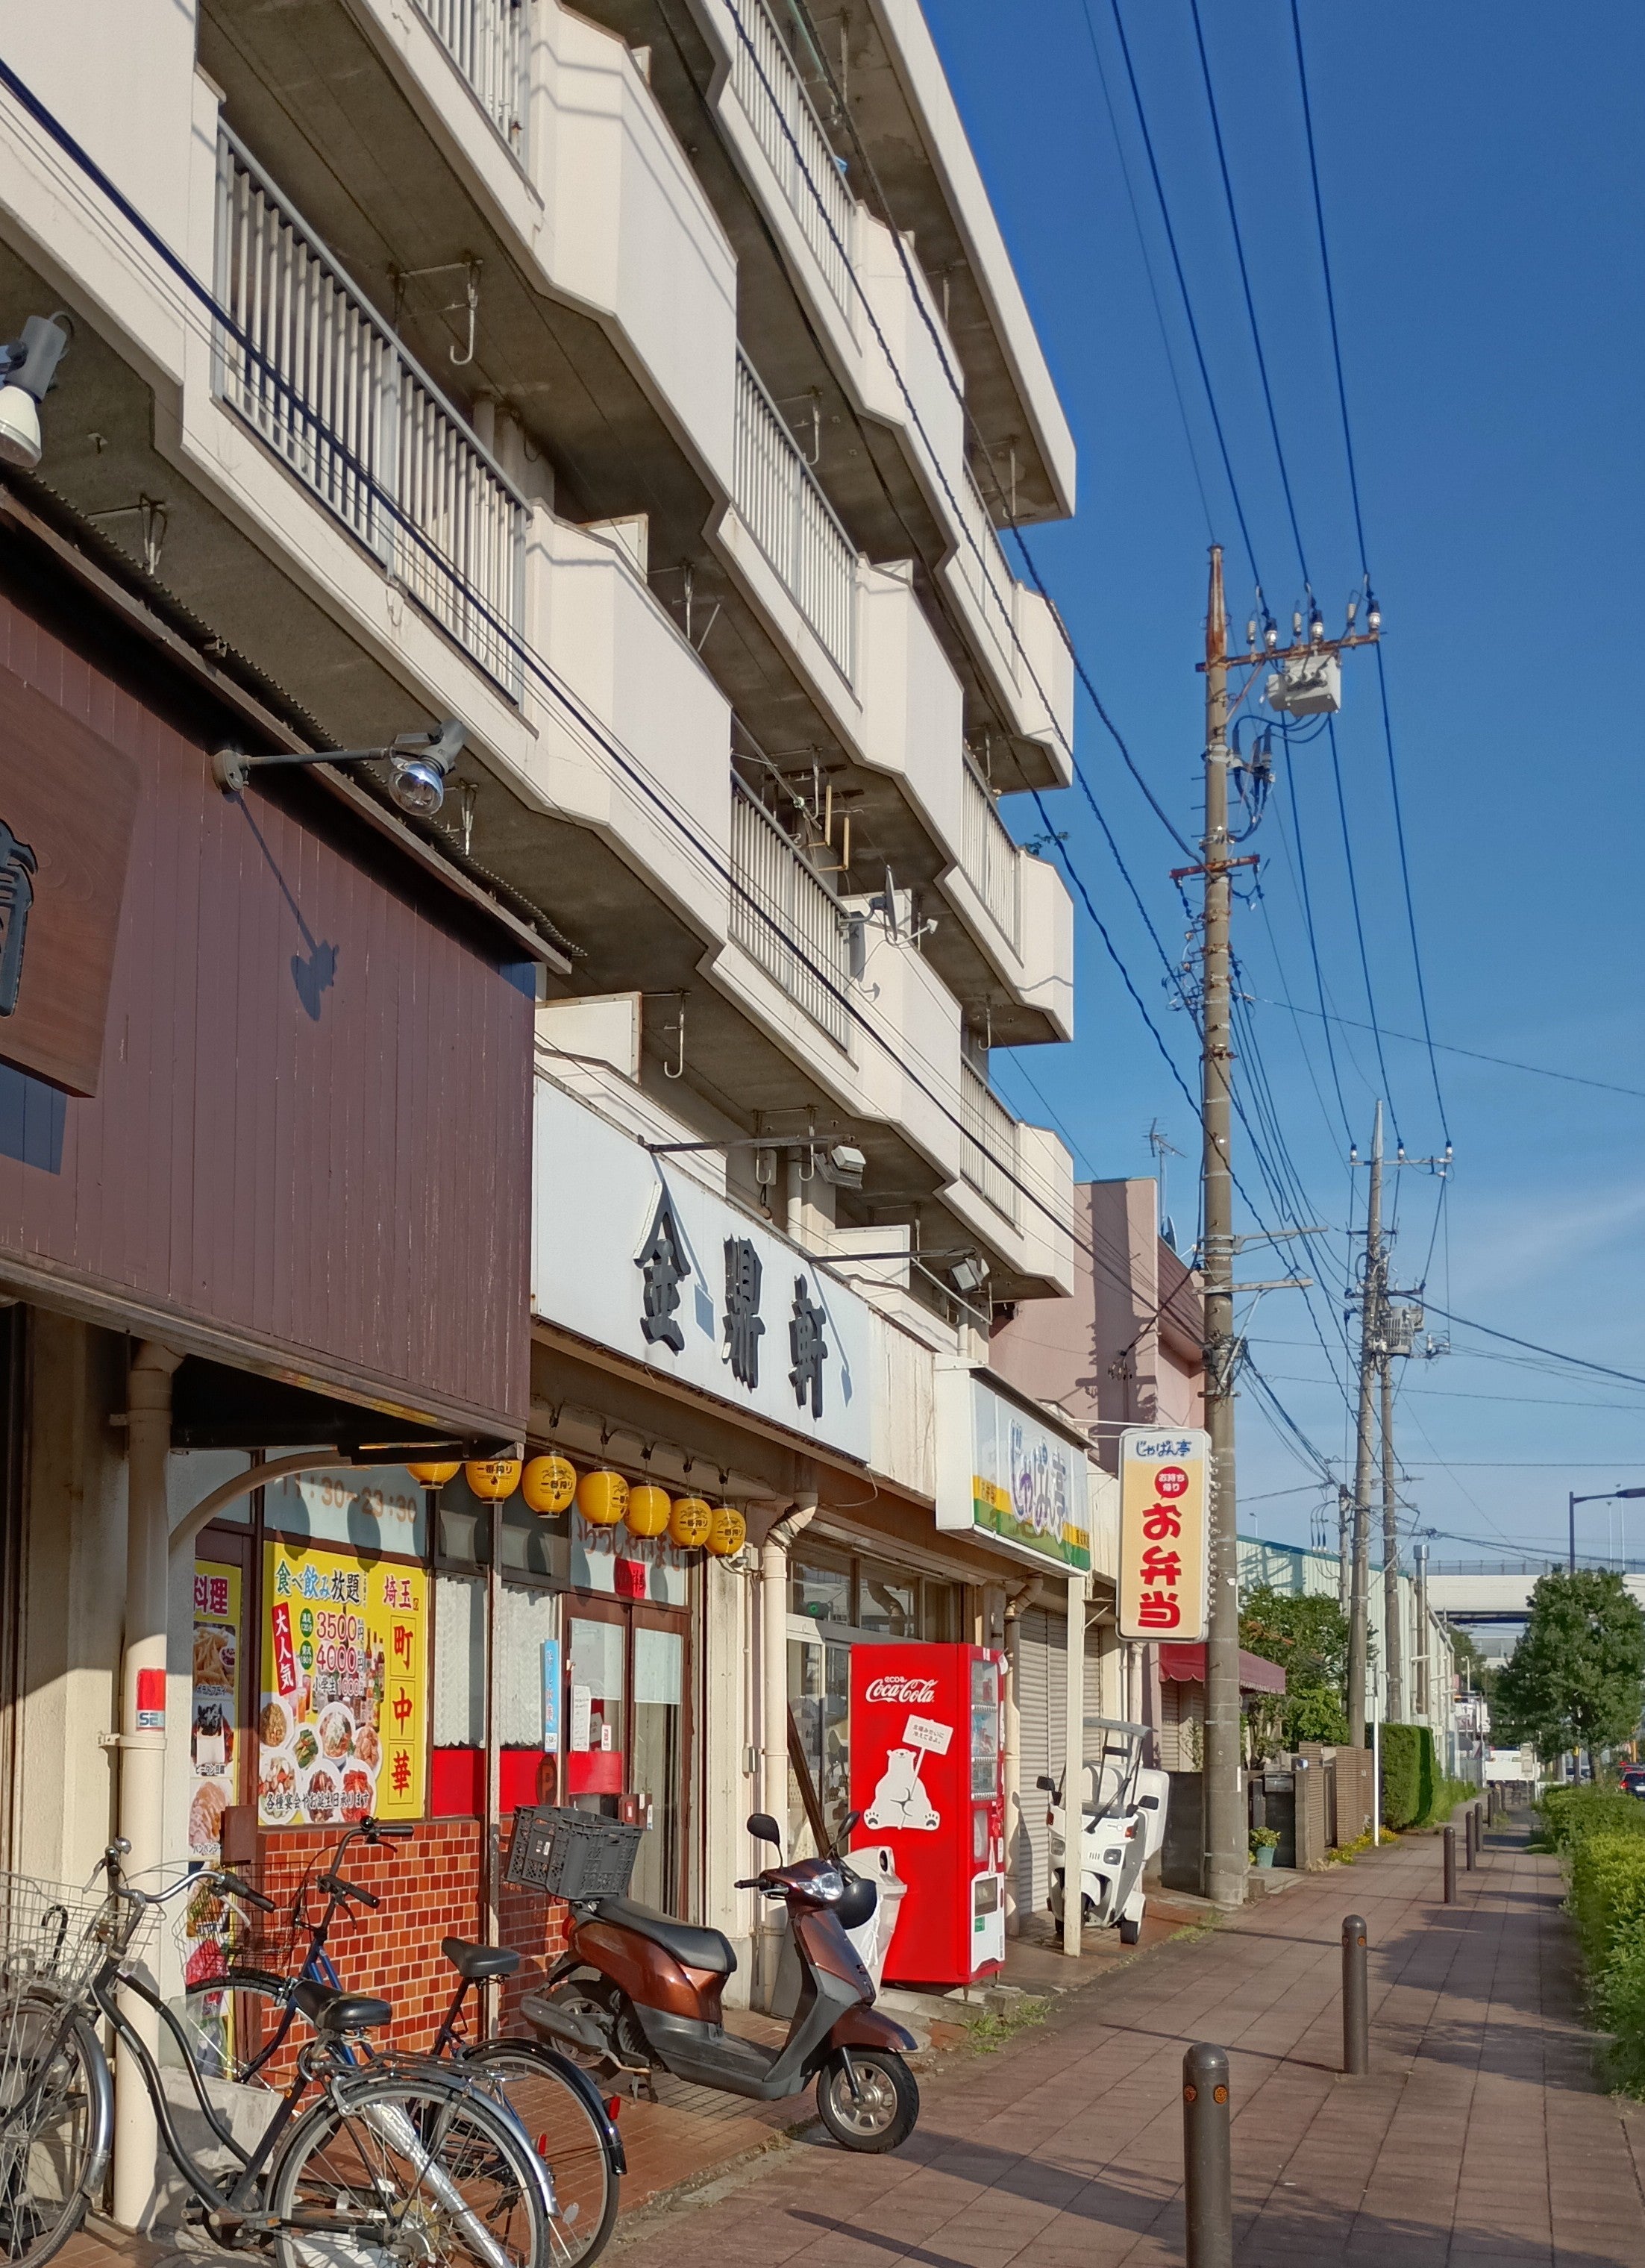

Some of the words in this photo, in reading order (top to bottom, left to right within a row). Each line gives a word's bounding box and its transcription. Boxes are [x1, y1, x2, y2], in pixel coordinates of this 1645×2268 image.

[1136, 1440, 1192, 1457] じゃぱん亭
[275, 1560, 360, 1603] 食べ飲み放題
[1138, 1503, 1182, 1629] お弁当
[275, 1608, 295, 1691] 大人気
[391, 1625, 414, 1799] 町中華
[865, 1679, 939, 1703] Coca-Cola
